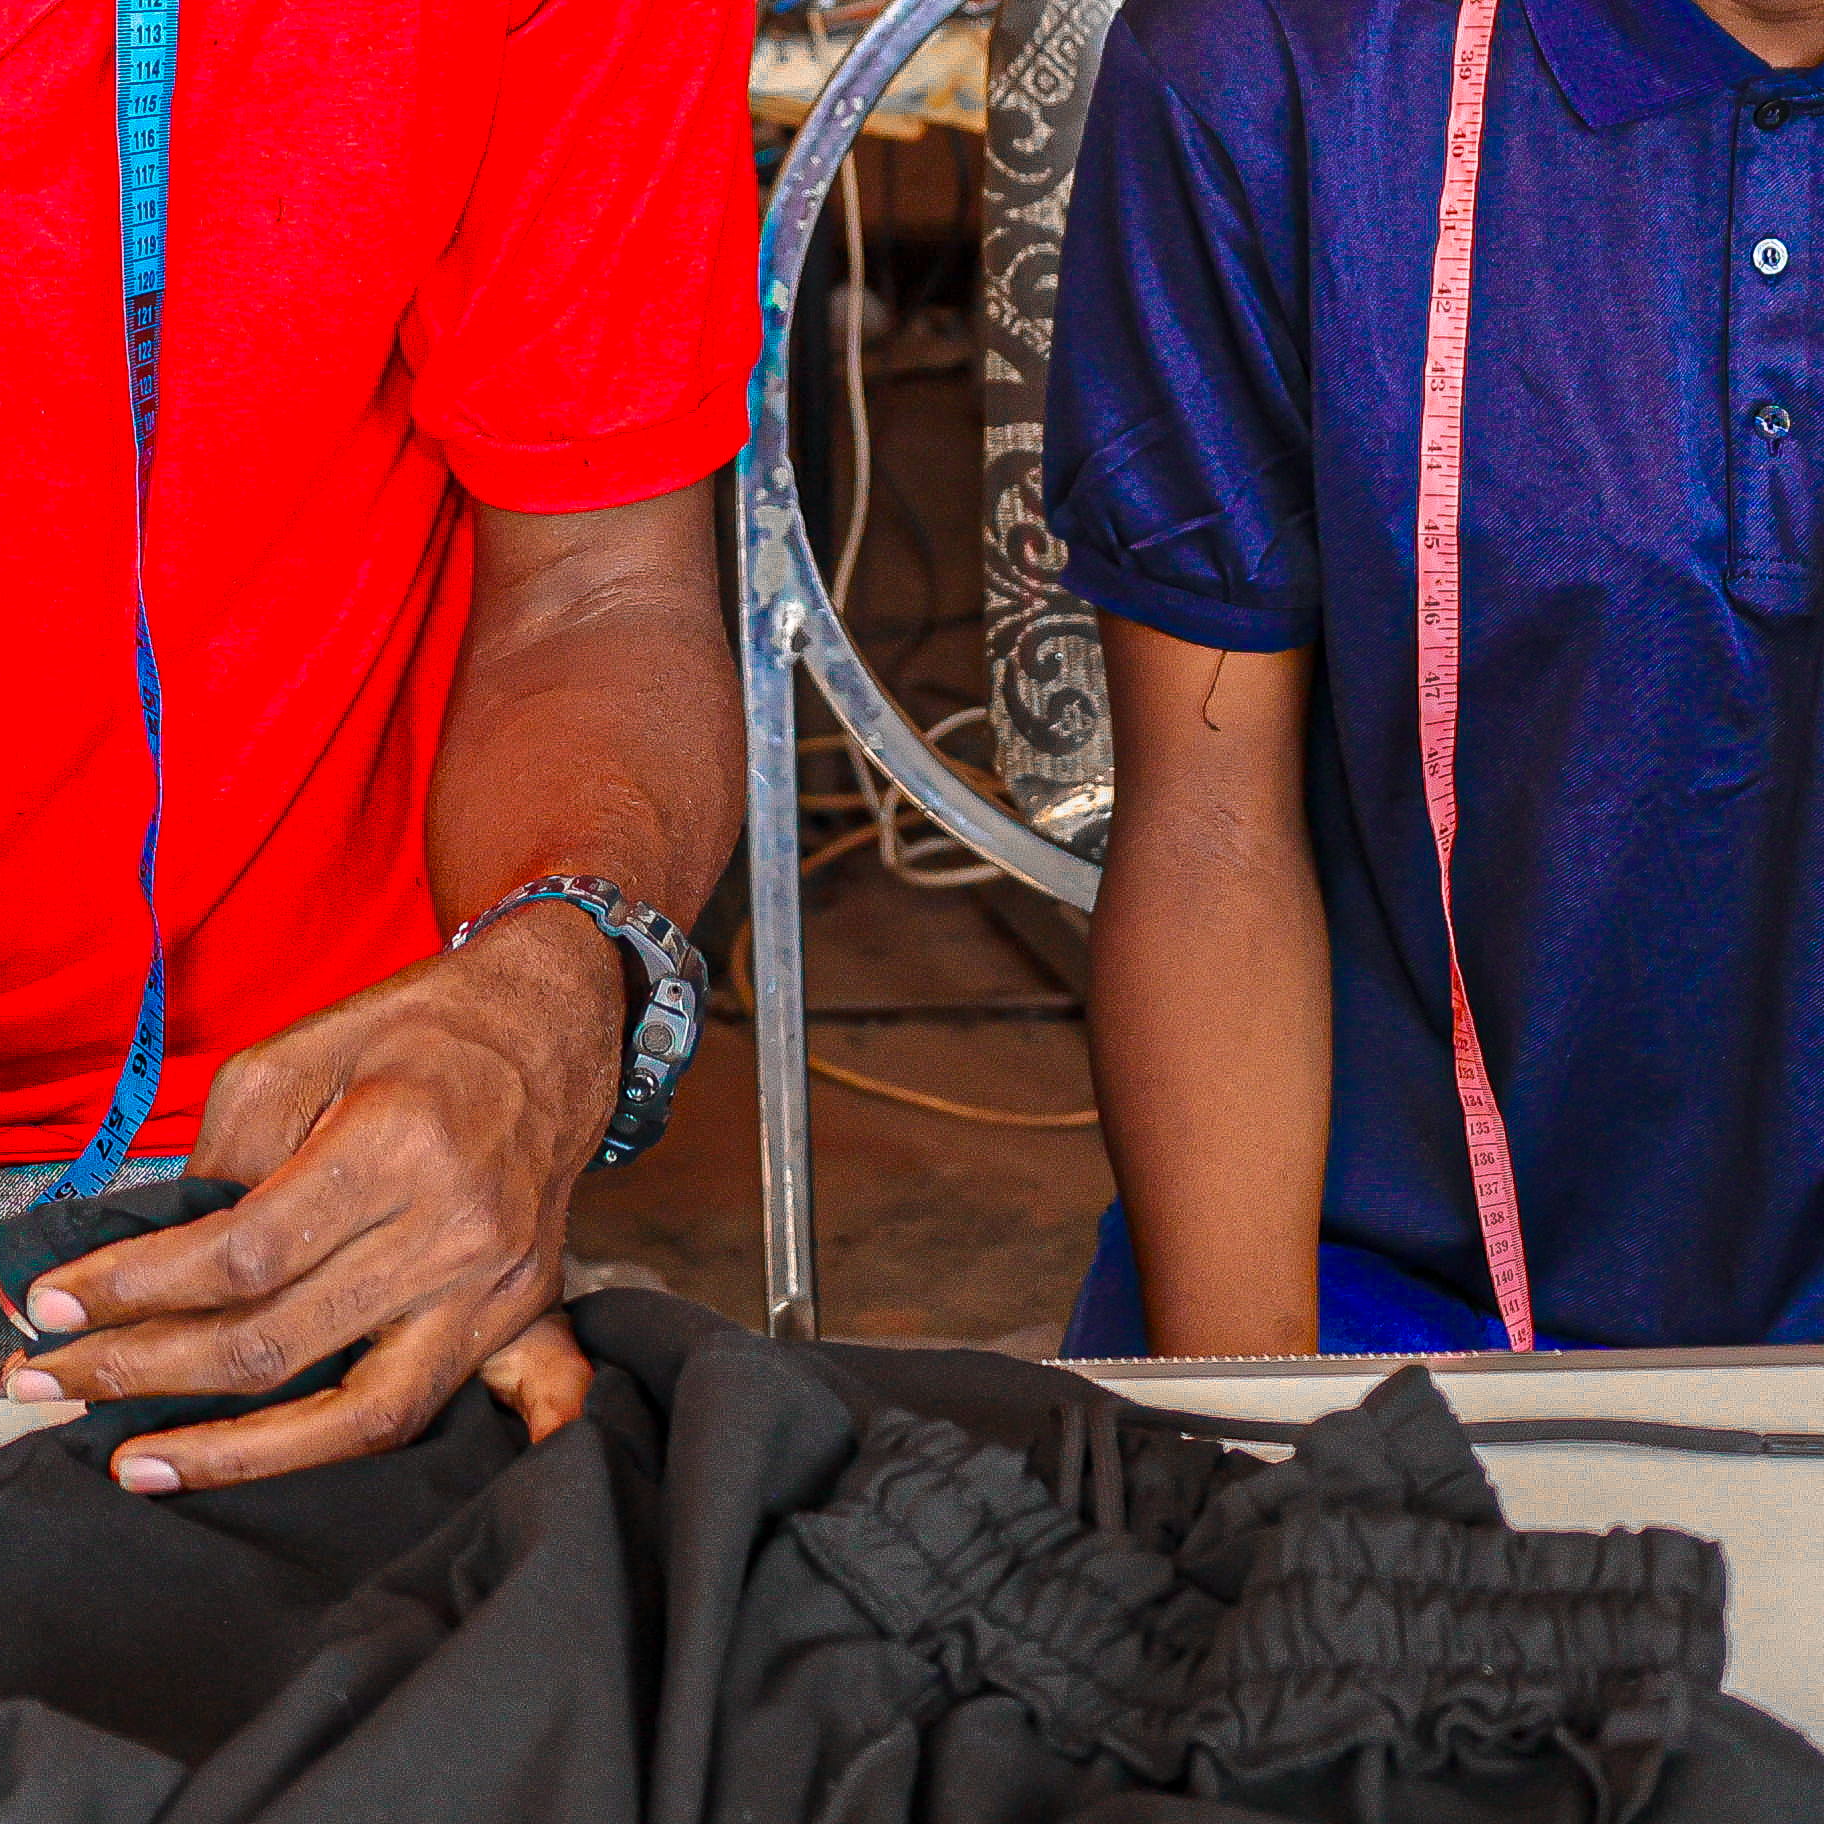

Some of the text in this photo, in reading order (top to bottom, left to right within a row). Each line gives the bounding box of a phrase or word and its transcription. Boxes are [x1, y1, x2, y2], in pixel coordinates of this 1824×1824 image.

[137, 24, 161, 42] 113
[137, 60, 159, 79] 114
[134, 95, 156, 113] 115
[133, 130, 154, 149] 116
[134, 165, 155, 184] 117
[137, 201, 155, 220] 118
[137, 236, 156, 255] 119
[137, 270, 155, 290] 120
[137, 305, 152, 325] 121
[138, 340, 152, 360] 122
[1469, 1122, 1490, 1136] 135
[1474, 1151, 1495, 1167] 136
[1478, 1182, 1498, 1197] 137
[1484, 1211, 1504, 1227] 138
[1489, 1241, 1508, 1257] 139
[1495, 1270, 1514, 1287] 140
[1503, 1300, 1520, 1316] 141
